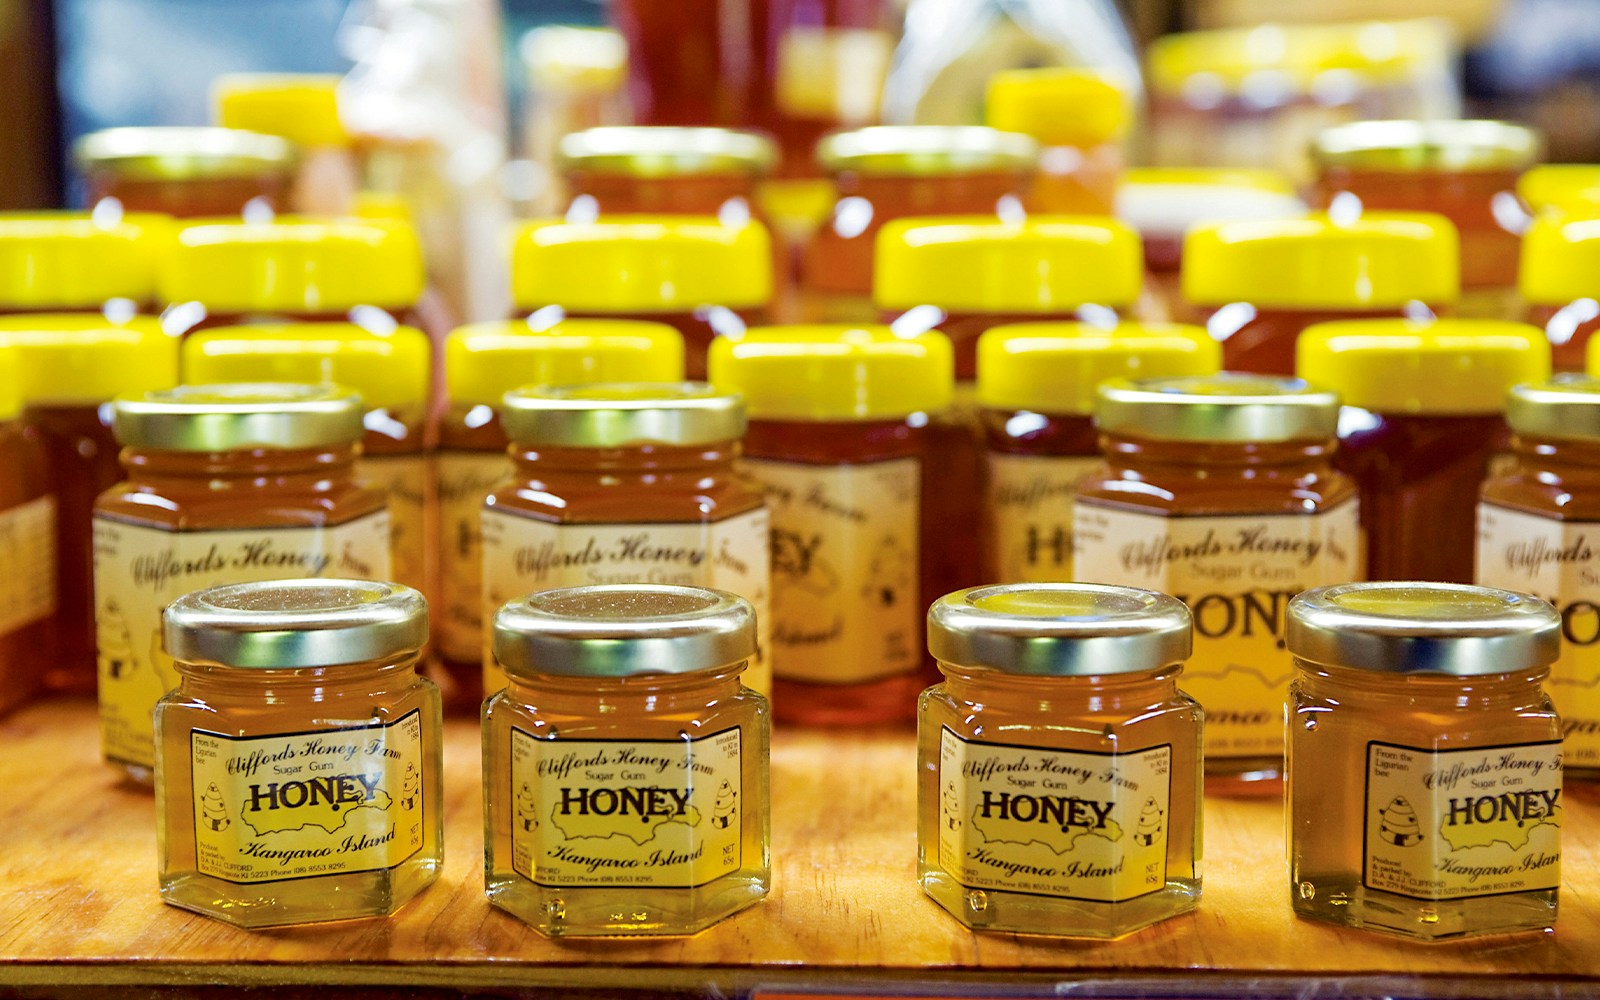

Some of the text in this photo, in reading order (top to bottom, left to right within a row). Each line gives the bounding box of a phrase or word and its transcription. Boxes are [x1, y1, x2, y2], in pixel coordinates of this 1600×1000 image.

[131, 543, 225, 592] Cliffords
[231, 537, 330, 578] Honey
[514, 537, 603, 582] Cliffords
[611, 533, 704, 568] Honey
[1121, 529, 1221, 578] Cliffords
[1229, 525, 1321, 568] Honey
[1506, 535, 1591, 579] Cliffords
[226, 738, 401, 777] Cliffords Honey Farm
[273, 761, 334, 776] Sugar Gum
[537, 747, 713, 780] Cliffords Honey Farm
[1375, 748, 1413, 761] From the
[1375, 759, 1410, 771] Ligurian
[585, 770, 646, 782] Sugar Gum
[963, 756, 1139, 791] Cliffords Honey Farm
[1007, 776, 1067, 790] Sugar Gum
[1375, 768, 1389, 777] bee
[1423, 757, 1492, 791] Cliffords
[1494, 752, 1544, 777] Honey
[1471, 776, 1523, 790] Sugar Gum
[249, 771, 382, 812] HONEY
[561, 787, 694, 816] HONEY
[981, 791, 1115, 829] HONEY
[1448, 788, 1561, 826] HONEY
[239, 822, 395, 867] Kangaroo Island
[547, 846, 638, 873] Kangaroo
[644, 840, 704, 867] Island
[723, 843, 735, 856] NET
[224, 863, 253, 872] CLIFFORD
[271, 869, 292, 877] Phone
[309, 865, 326, 873] 8553
[966, 848, 1057, 878] Kangaroo
[1061, 855, 1125, 878] Island
[1146, 862, 1159, 874] NET
[1434, 859, 1514, 883] Kangaroo
